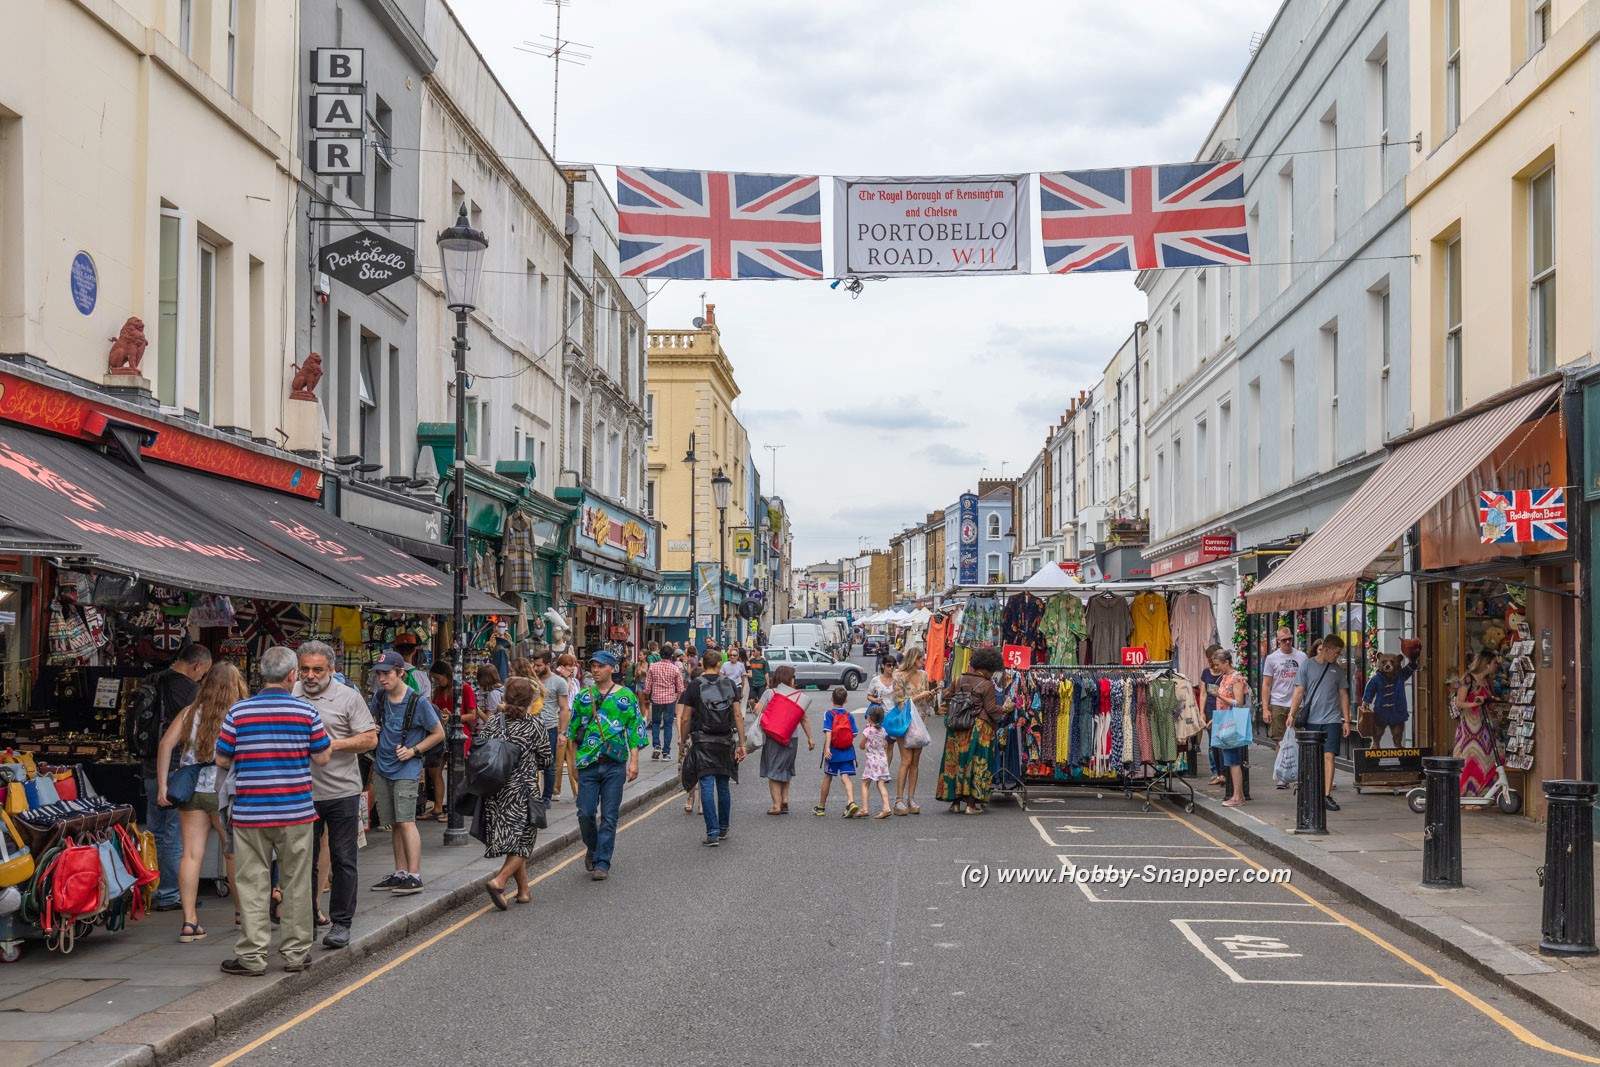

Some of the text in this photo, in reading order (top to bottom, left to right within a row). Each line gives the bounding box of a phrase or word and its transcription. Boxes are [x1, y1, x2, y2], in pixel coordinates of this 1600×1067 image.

[324, 54, 354, 168] BAR
[858, 188, 1004, 204] The Royal Borough of Kensington
[905, 206, 957, 218] and Chelsea
[857, 222, 1007, 241] PORTOBELLO
[326, 246, 406, 271] Portobello
[868, 247, 995, 266] ROAD, W.11
[358, 262, 392, 280] Star
[1507, 460, 1551, 490] House
[1510, 508, 1562, 520] Paddington Bear
[1008, 651, 1022, 666] £5
[1126, 651, 1144, 665] £10
[1213, 934, 1305, 960] 42A
